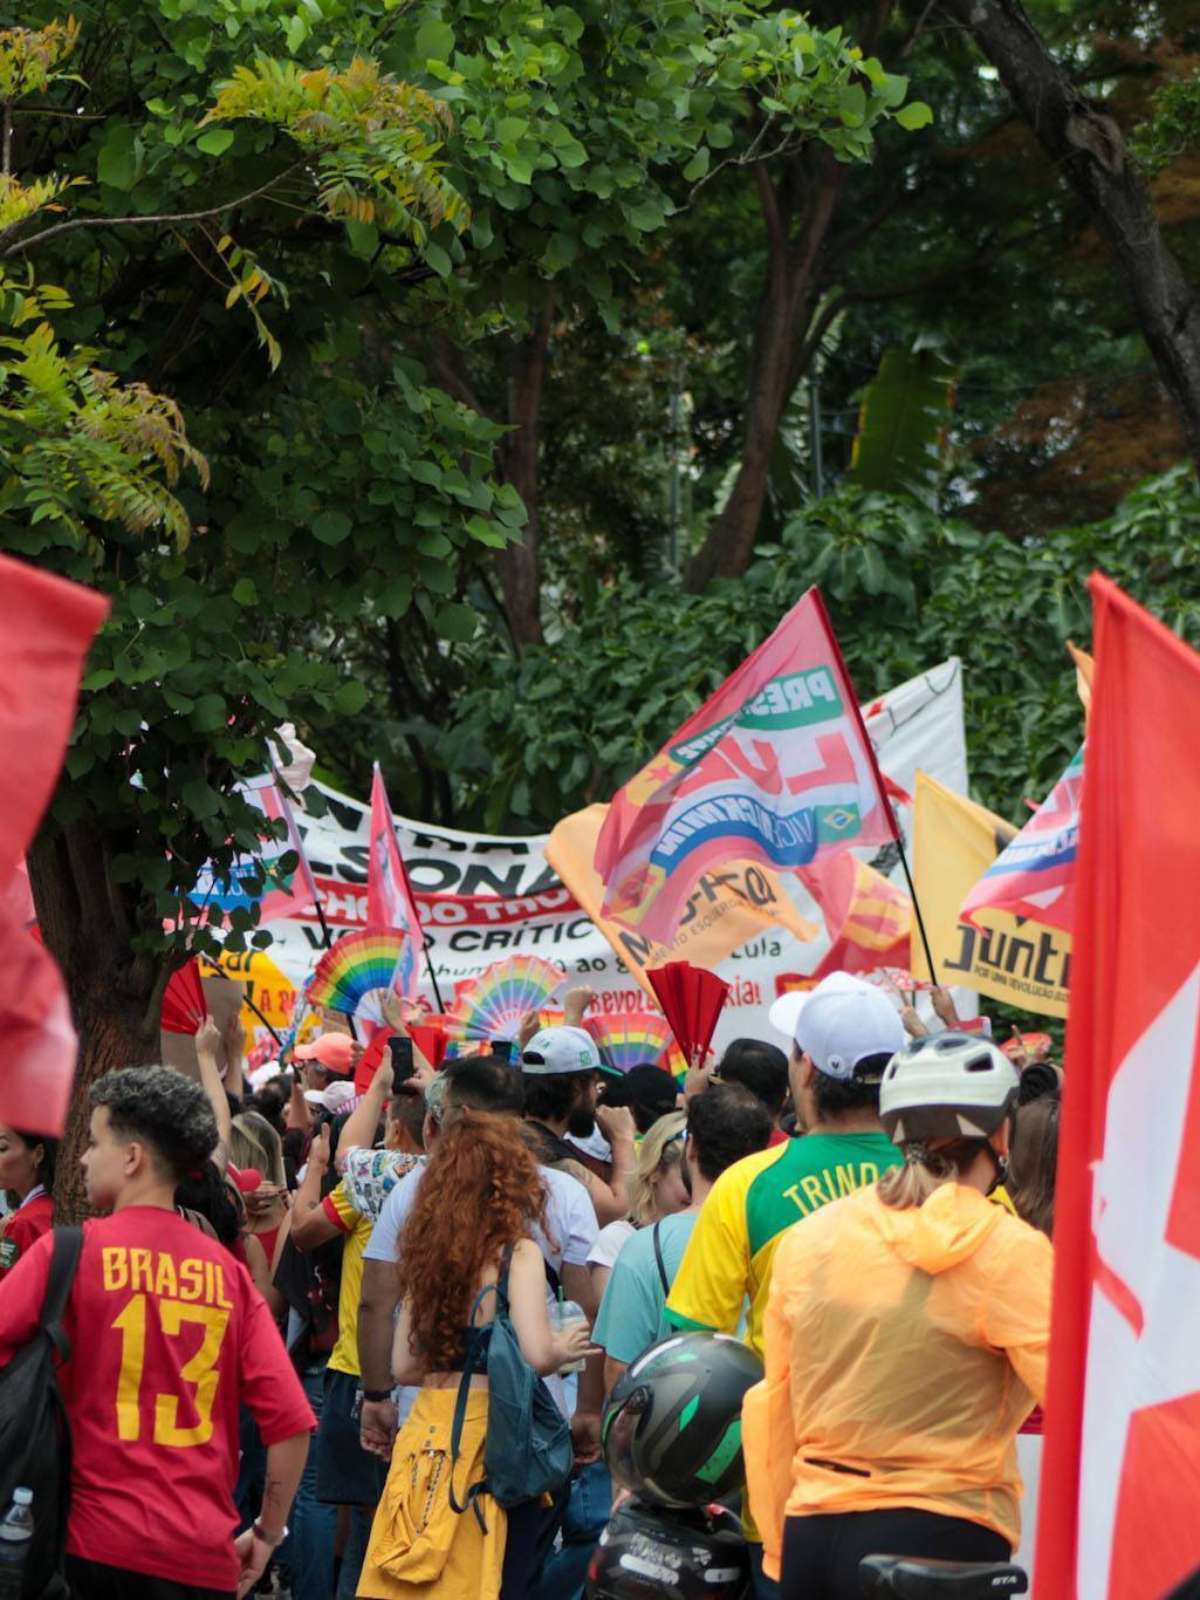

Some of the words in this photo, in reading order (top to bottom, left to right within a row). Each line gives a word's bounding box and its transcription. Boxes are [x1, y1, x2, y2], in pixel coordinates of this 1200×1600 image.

[449, 917, 595, 952] CRÍTIC
[576, 957, 607, 974] ao
[782, 1161, 881, 1217] TRIND
[102, 1246, 234, 1310] BRASIL
[111, 1293, 231, 1448] 13
